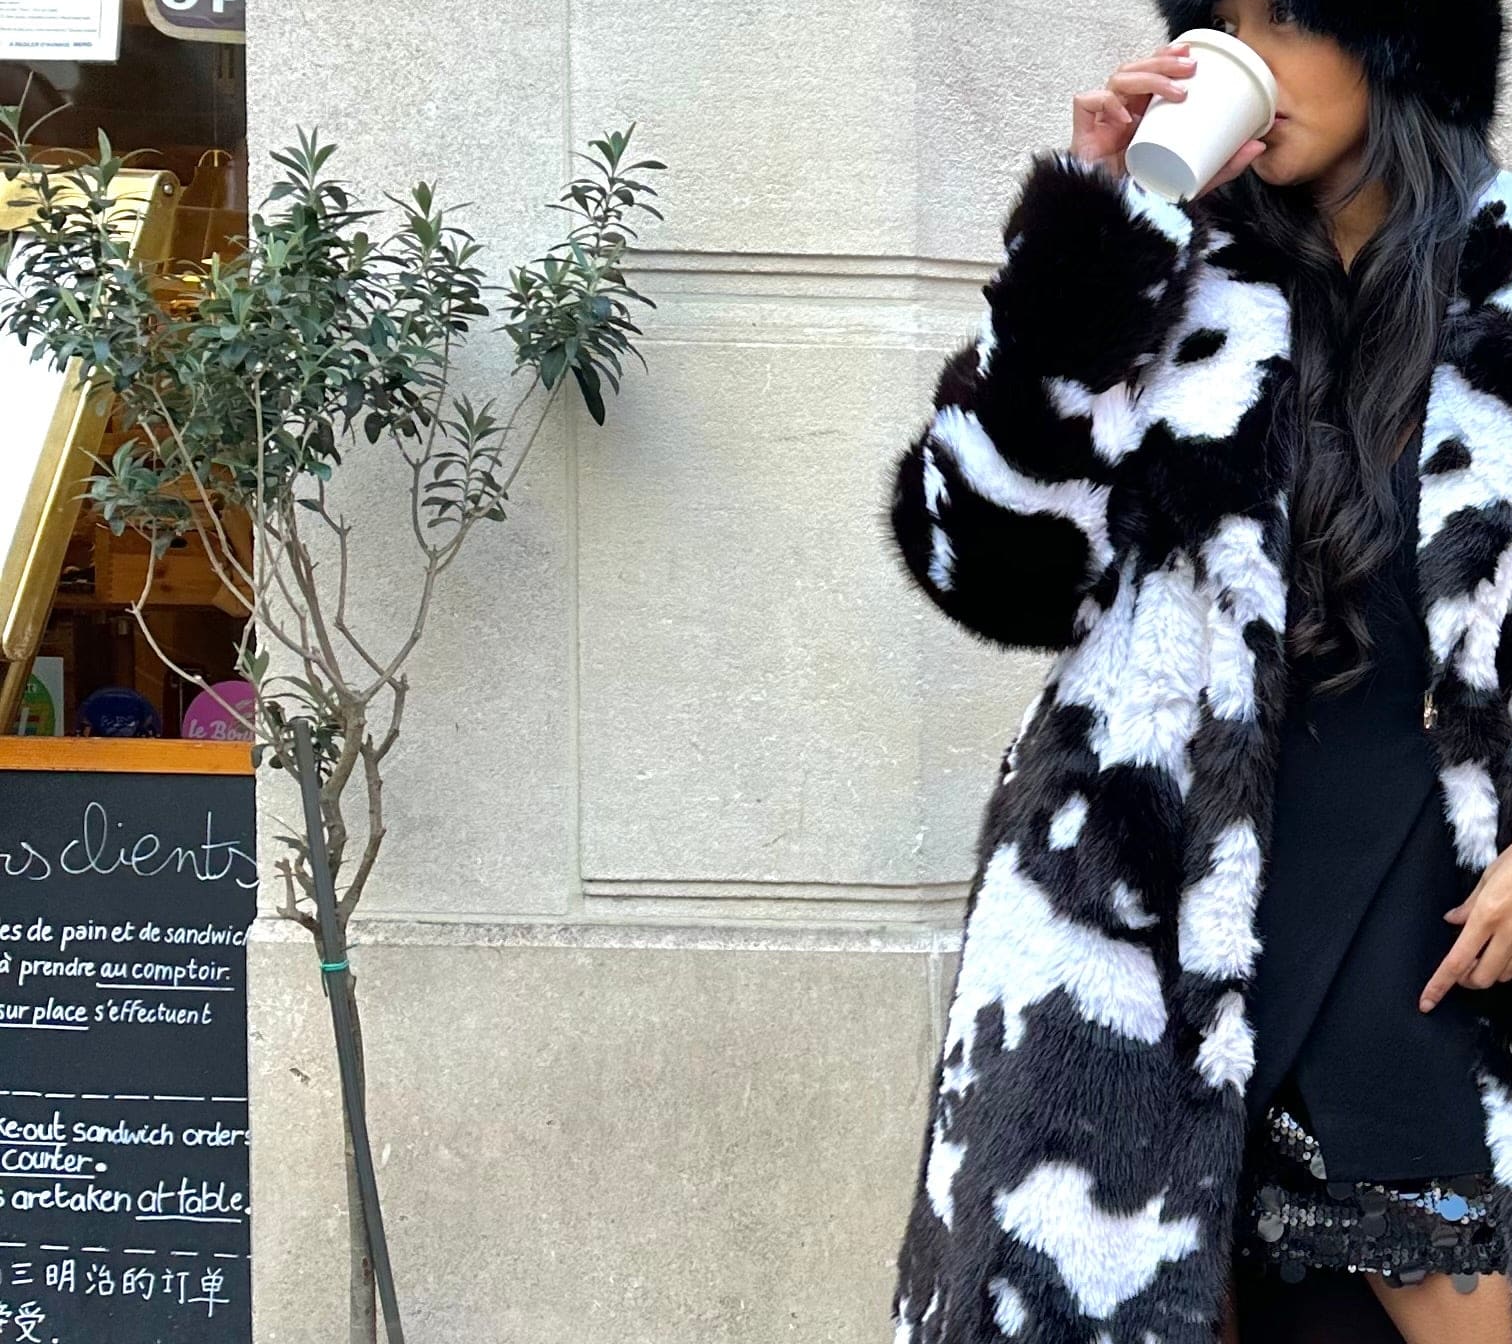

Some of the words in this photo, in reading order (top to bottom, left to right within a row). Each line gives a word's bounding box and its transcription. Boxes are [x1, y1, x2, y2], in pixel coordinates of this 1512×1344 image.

[60, 801, 260, 889] clients
[27, 916, 54, 942] de
[60, 919, 107, 952] pain
[111, 921, 136, 942] et
[139, 921, 161, 942] de
[18, 957, 96, 986] prendre
[100, 962, 127, 978] au
[131, 958, 231, 987] comptoir.
[32, 997, 89, 1025] place
[94, 999, 213, 1025] s'effectuent
[72, 1120, 174, 1145] sandwich
[137, 1180, 175, 1213] at
